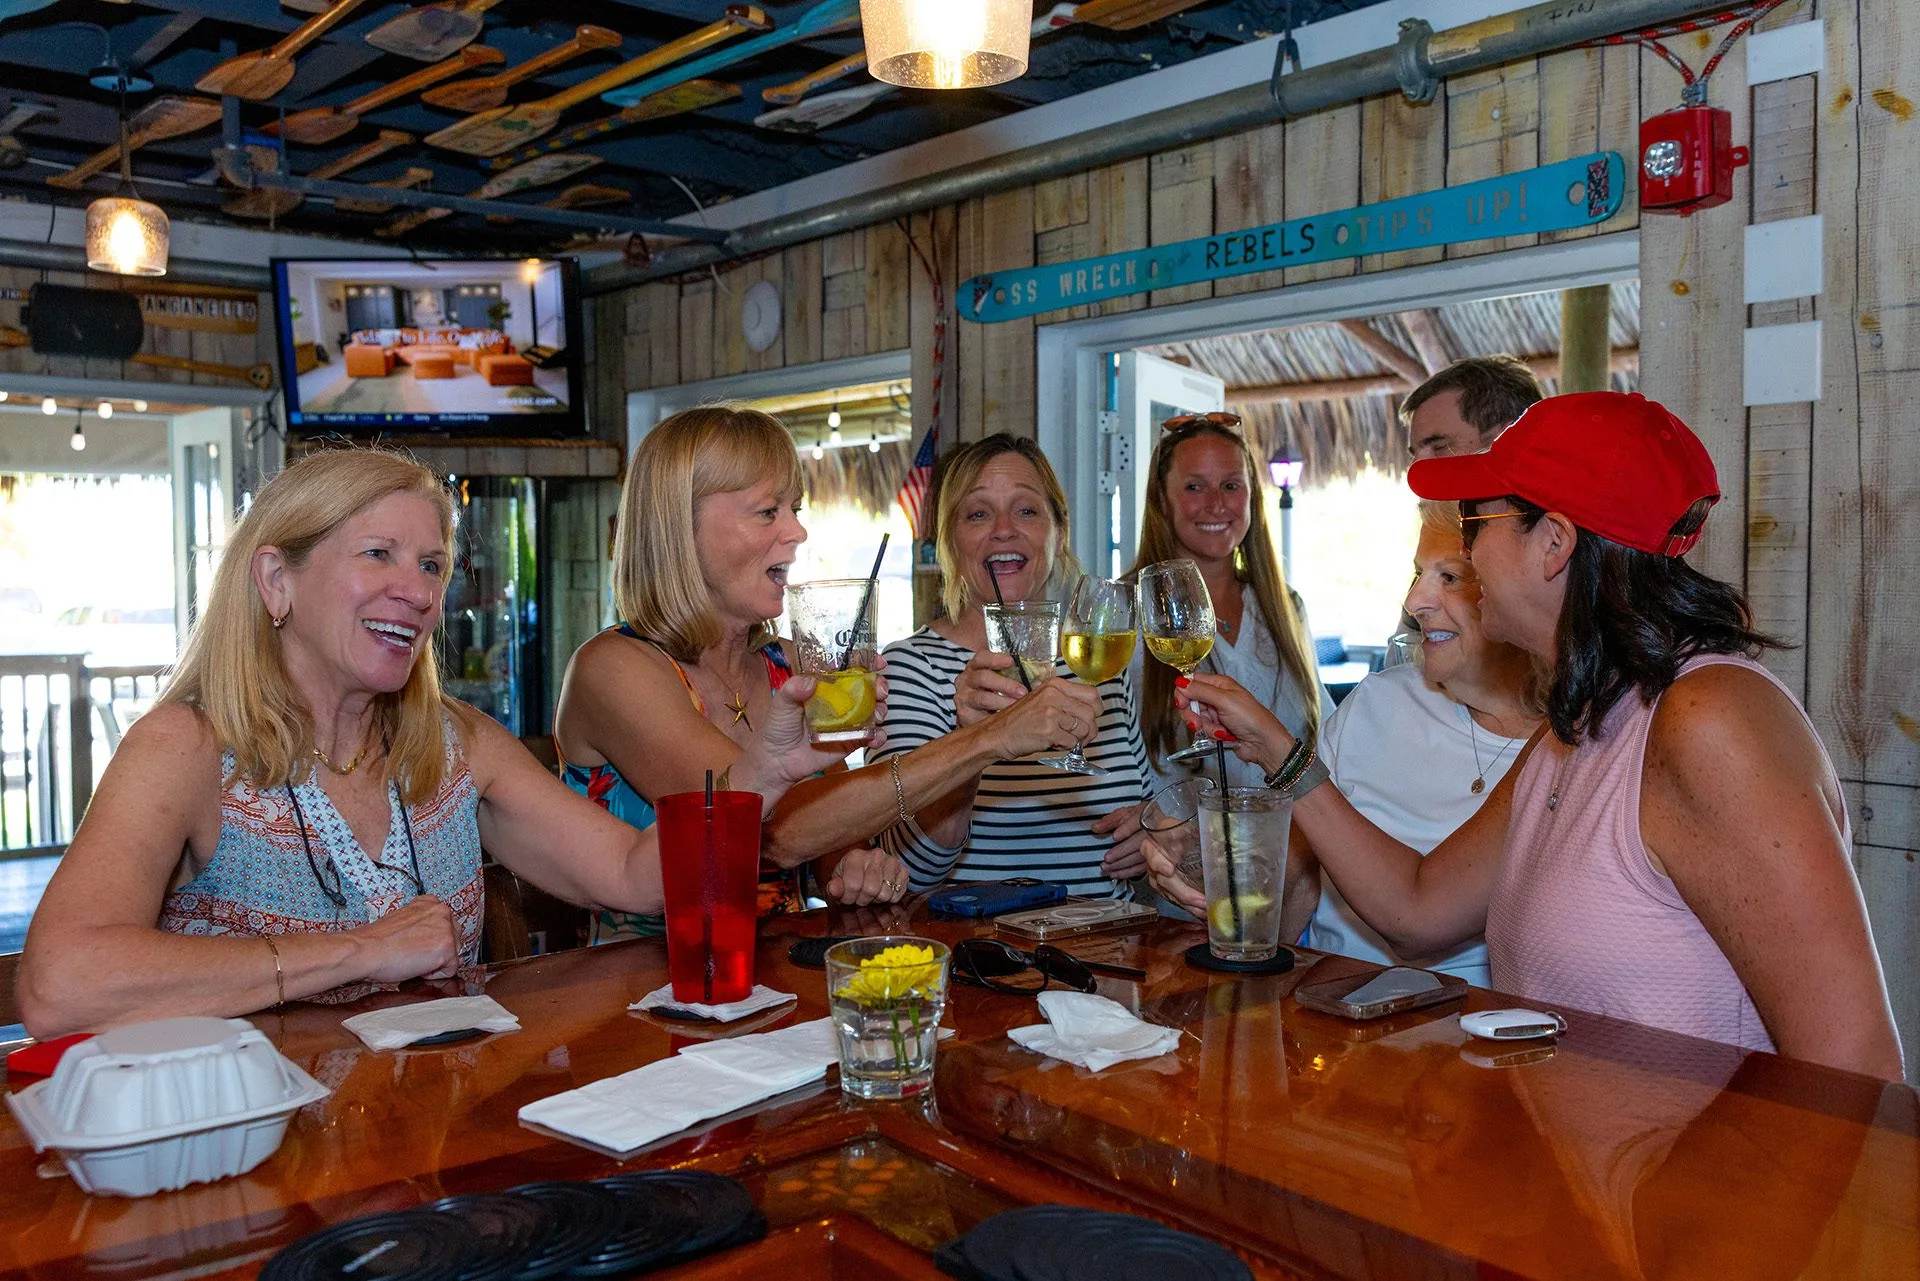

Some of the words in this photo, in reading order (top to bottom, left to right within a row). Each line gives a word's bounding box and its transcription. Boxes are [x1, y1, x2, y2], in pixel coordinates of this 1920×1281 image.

[1011, 279, 1038, 305] SS
[1059, 260, 1137, 298] WRECK
[1206, 223, 1316, 270] REBELS
[1356, 207, 1434, 244] TIPS
[1466, 180, 1527, 225] UP!
